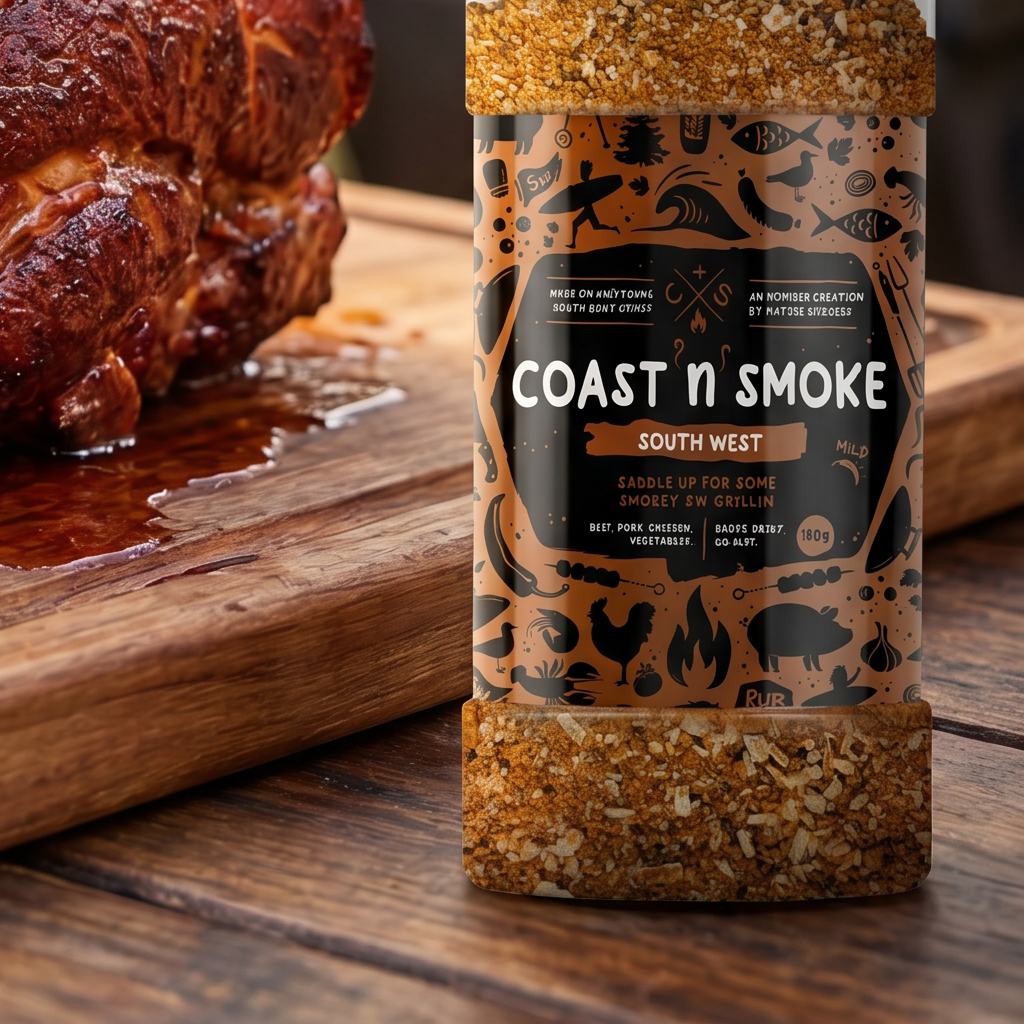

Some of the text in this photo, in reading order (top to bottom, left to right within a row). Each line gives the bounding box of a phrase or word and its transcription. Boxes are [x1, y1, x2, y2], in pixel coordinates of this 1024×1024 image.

[578, 289, 594, 298] ON
[749, 292, 764, 302] AN
[813, 292, 864, 302] CREATION
[552, 303, 586, 312] SOUTH
[749, 306, 762, 316] BY
[512, 359, 668, 410] COAST
[735, 360, 887, 410] SMOKE
[638, 432, 763, 453] SOUTH WEST
[617, 476, 777, 489] SADDLE UP FOR SOME
[617, 523, 644, 532] PORK
[801, 529, 829, 543] 180g
